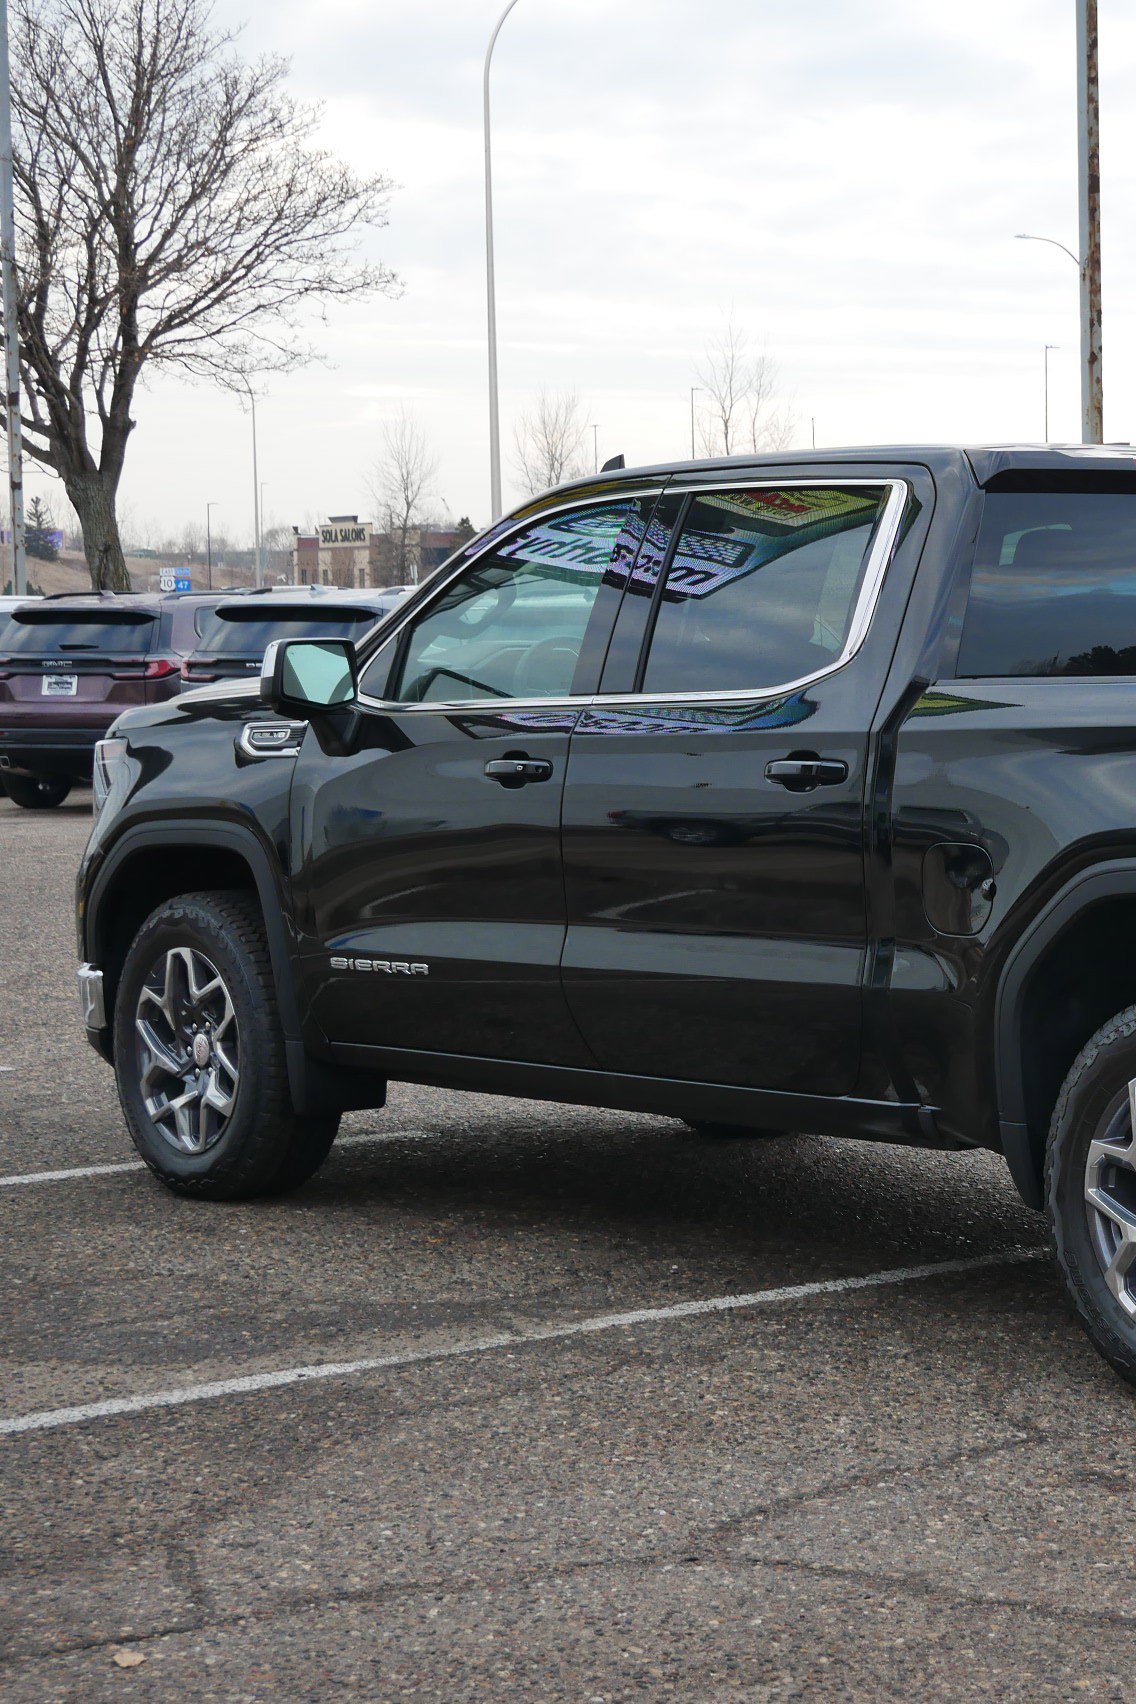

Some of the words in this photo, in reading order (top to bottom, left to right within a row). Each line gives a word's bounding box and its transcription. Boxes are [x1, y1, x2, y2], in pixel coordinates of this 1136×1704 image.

[321, 528, 339, 544] SOLA
[340, 527, 366, 542] SALONS
[163, 579, 173, 588] 10
[177, 581, 188, 590] 47
[330, 957, 429, 975] SIERRA
